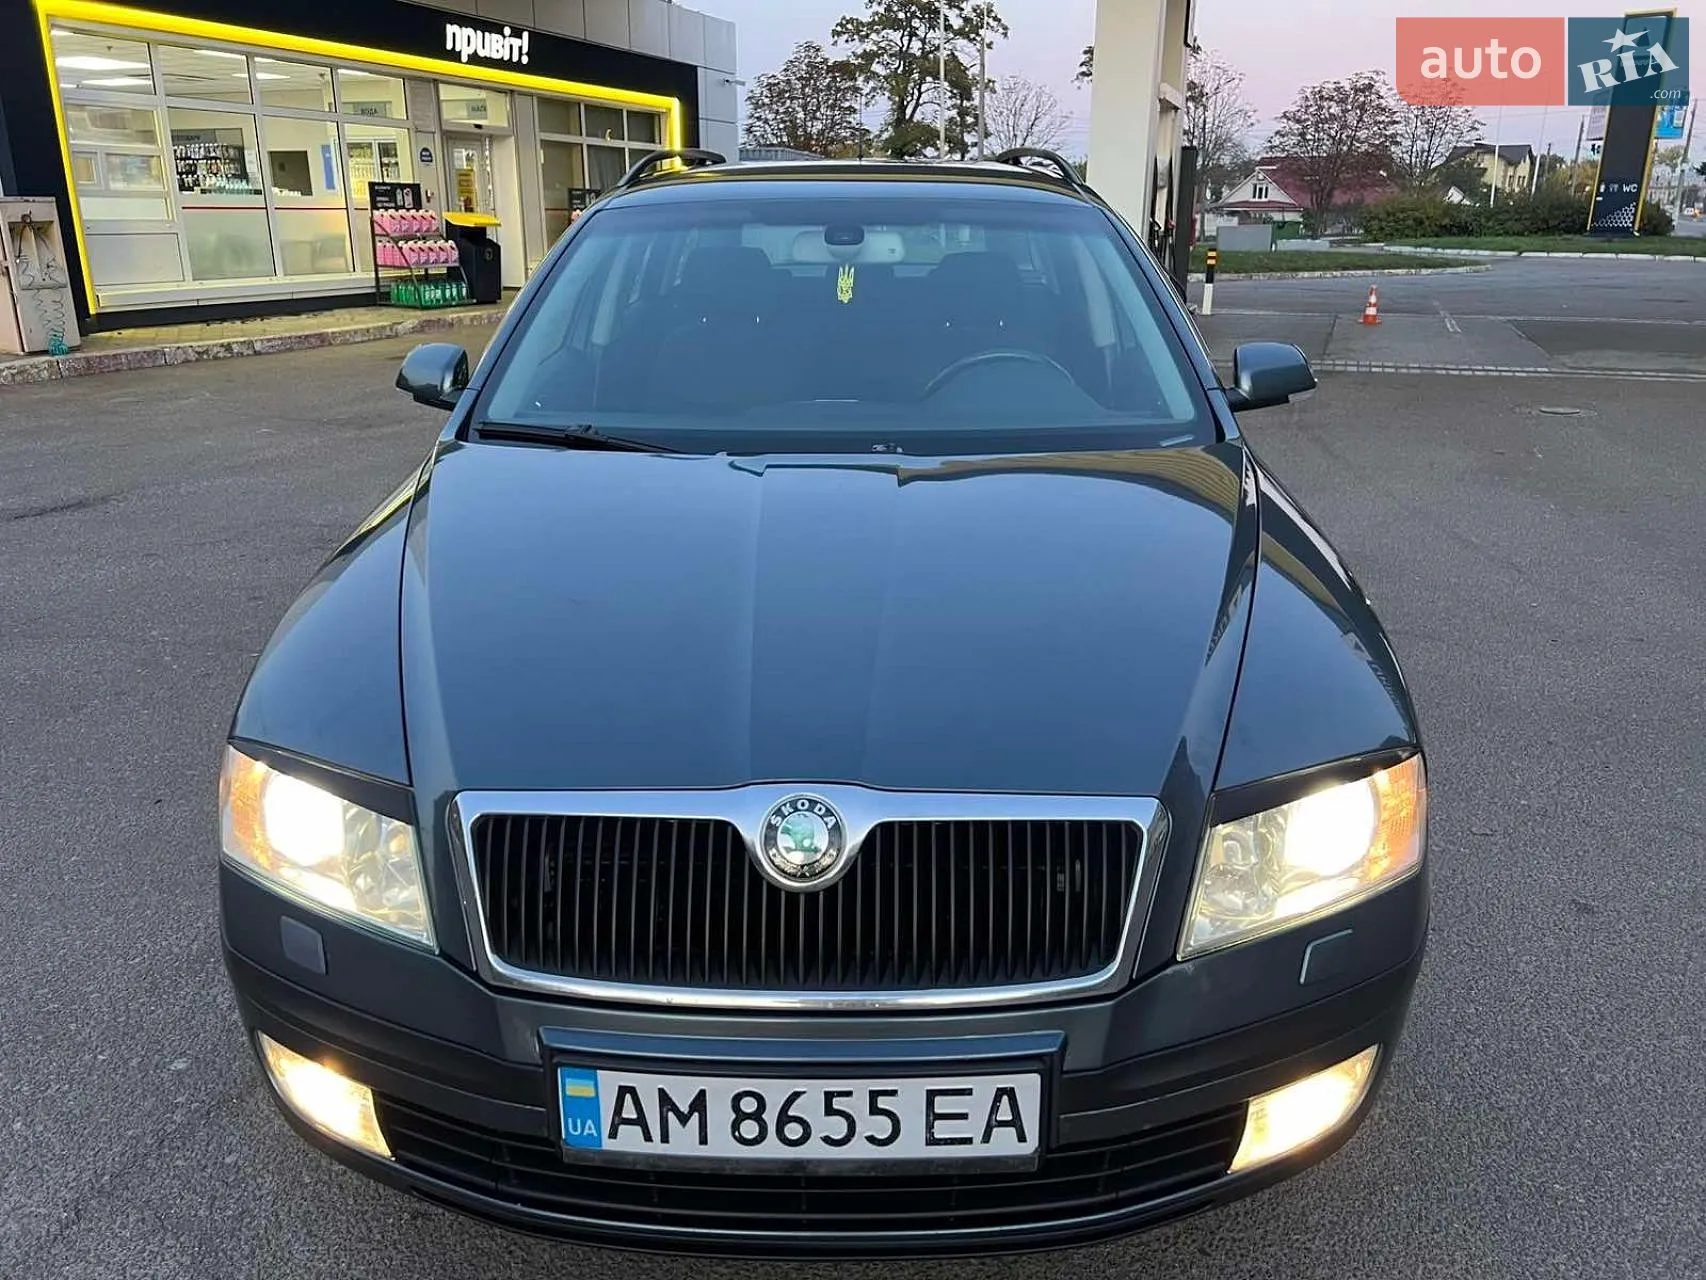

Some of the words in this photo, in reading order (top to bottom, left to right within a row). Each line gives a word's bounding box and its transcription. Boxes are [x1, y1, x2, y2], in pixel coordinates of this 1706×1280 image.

[446, 23, 529, 64] привіт!
[1622, 183, 1638, 192] WC
[567, 1117, 598, 1137] UA
[607, 1085, 709, 1146] AM
[730, 1089, 902, 1148] 8655
[925, 1086, 1028, 1146] EA
